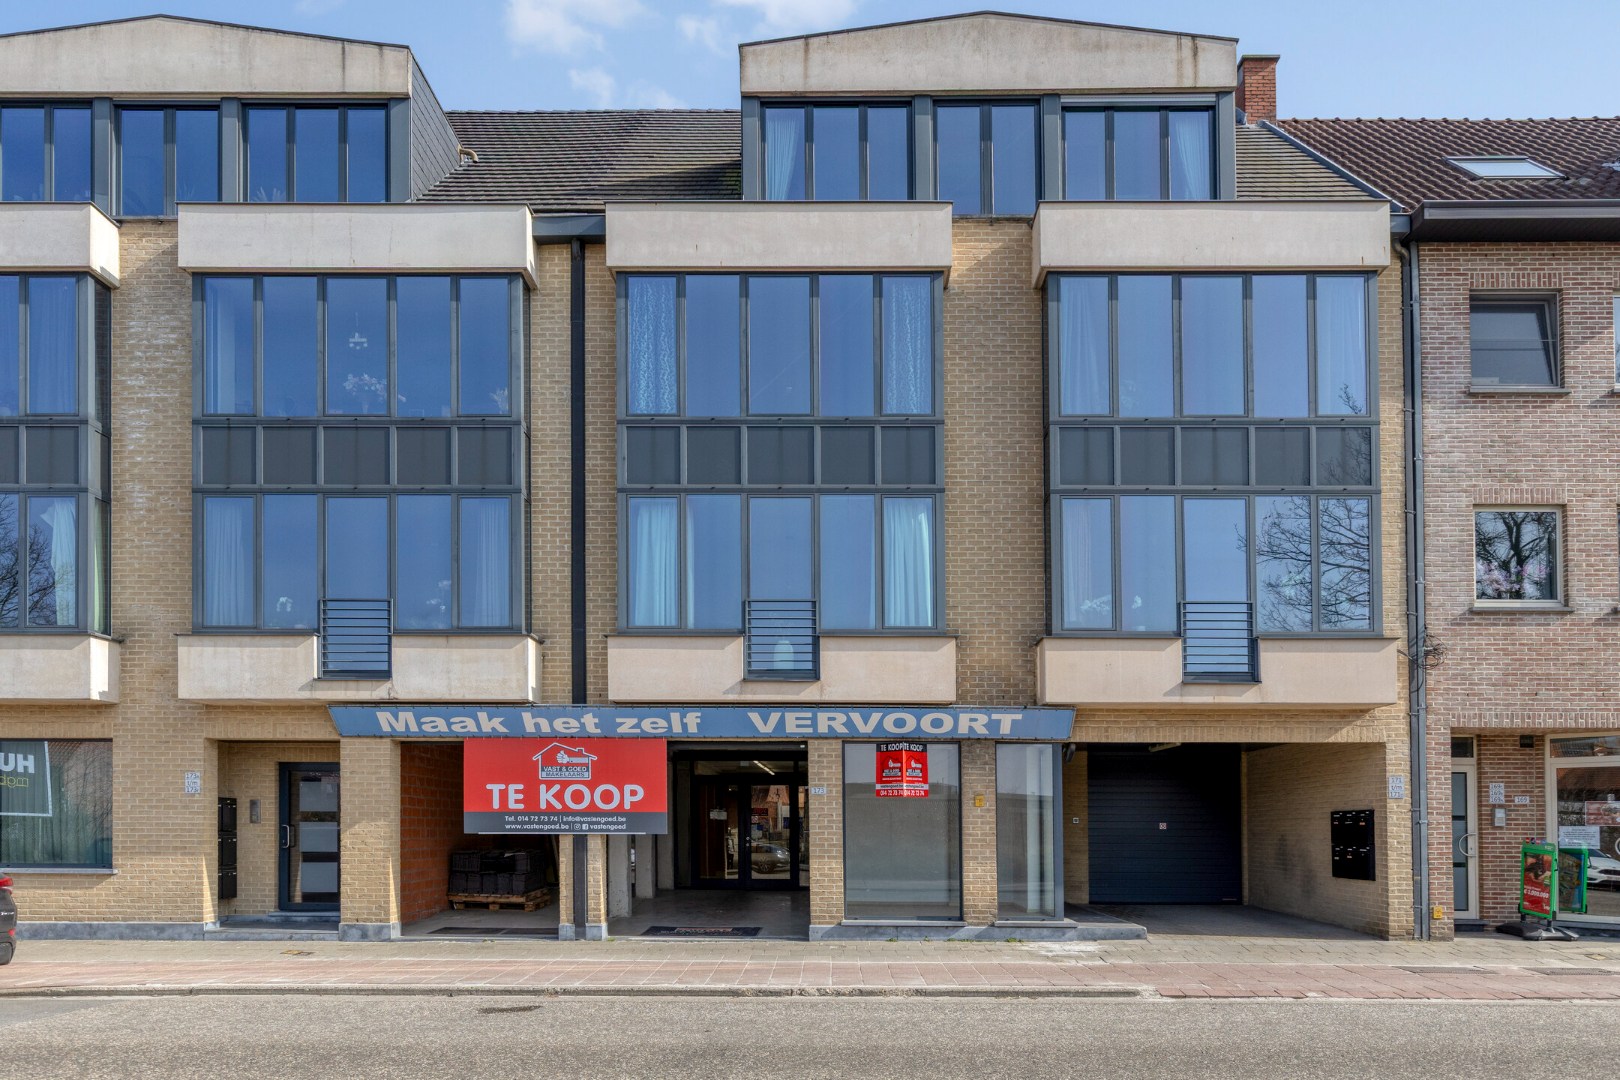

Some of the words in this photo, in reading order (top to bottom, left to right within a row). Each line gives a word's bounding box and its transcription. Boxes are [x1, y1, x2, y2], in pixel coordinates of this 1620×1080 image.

[376, 711, 509, 733] Maak
[521, 711, 602, 733] het
[615, 711, 702, 734] zelf
[747, 712, 1023, 735] VERVOORT
[888, 743, 903, 751] KOOP
[485, 783, 525, 810] TE
[539, 783, 645, 810] KOOP
[563, 815, 627, 823] info@vastengoed.be
